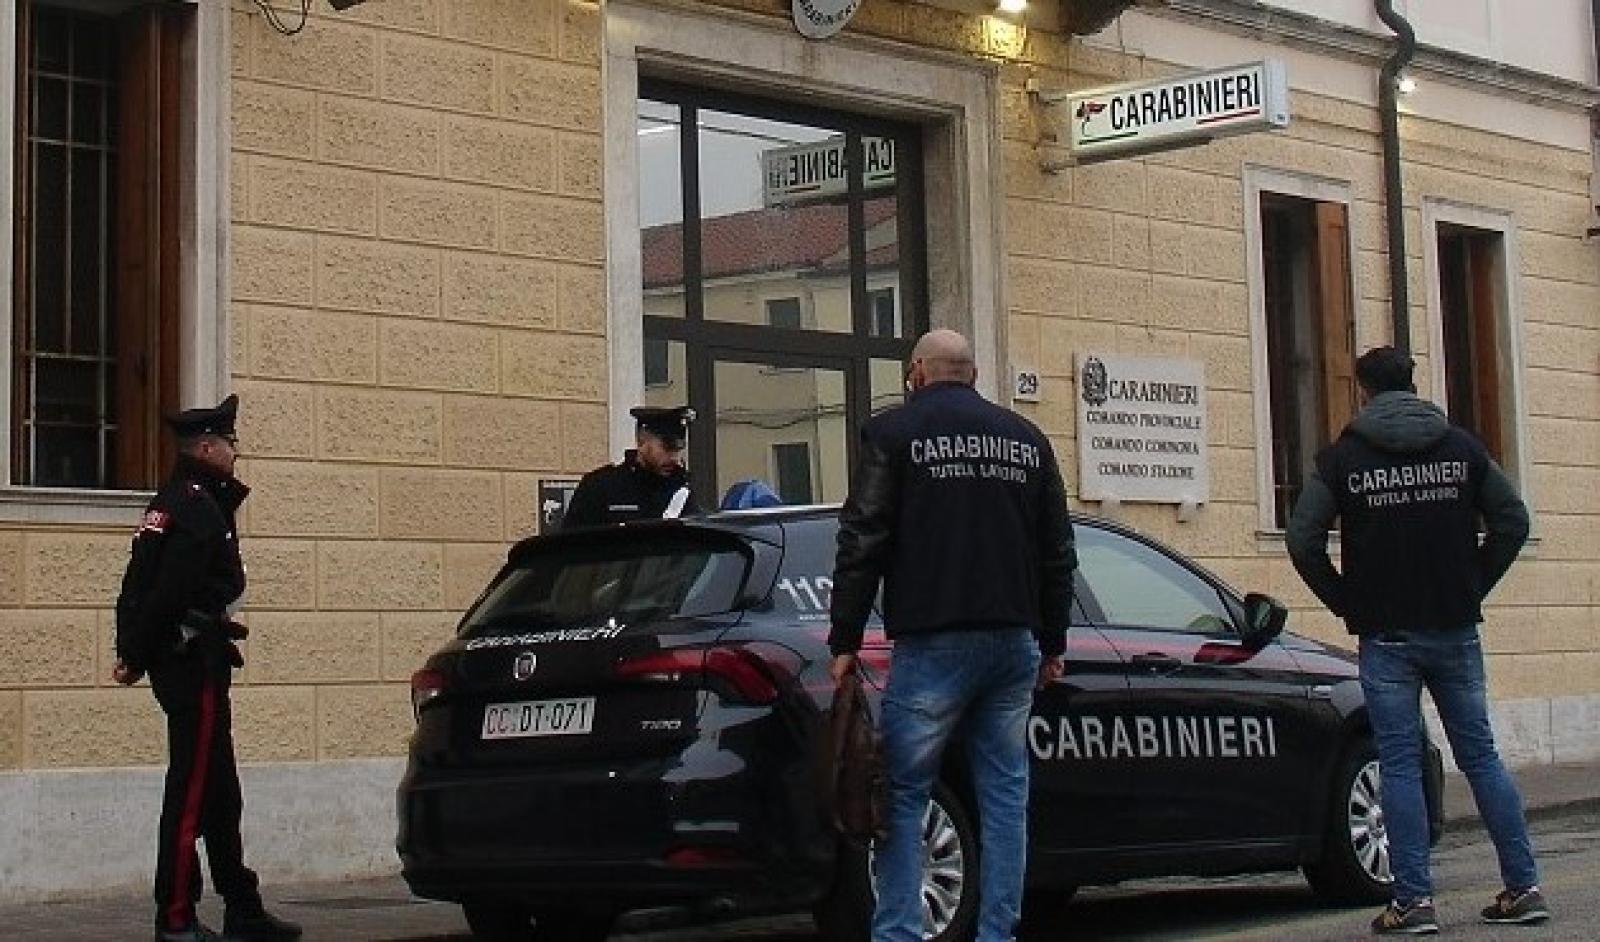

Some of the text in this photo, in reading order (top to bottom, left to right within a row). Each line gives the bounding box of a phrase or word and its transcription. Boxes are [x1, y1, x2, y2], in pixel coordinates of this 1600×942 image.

[1110, 73, 1261, 130] CARABINIERI
[1017, 372, 1037, 394] 29
[1109, 380, 1199, 405] CARABINIERI
[1086, 411, 1138, 425] COMANDO
[911, 434, 1039, 468] CARABINIERI
[1092, 436, 1143, 452] COMANDO
[929, 463, 1027, 484] TUTELA LAVORO
[1098, 462, 1149, 477] COMANDO
[1348, 462, 1468, 494] CARABINIERI
[1028, 715, 1278, 760] CARABINIERI
